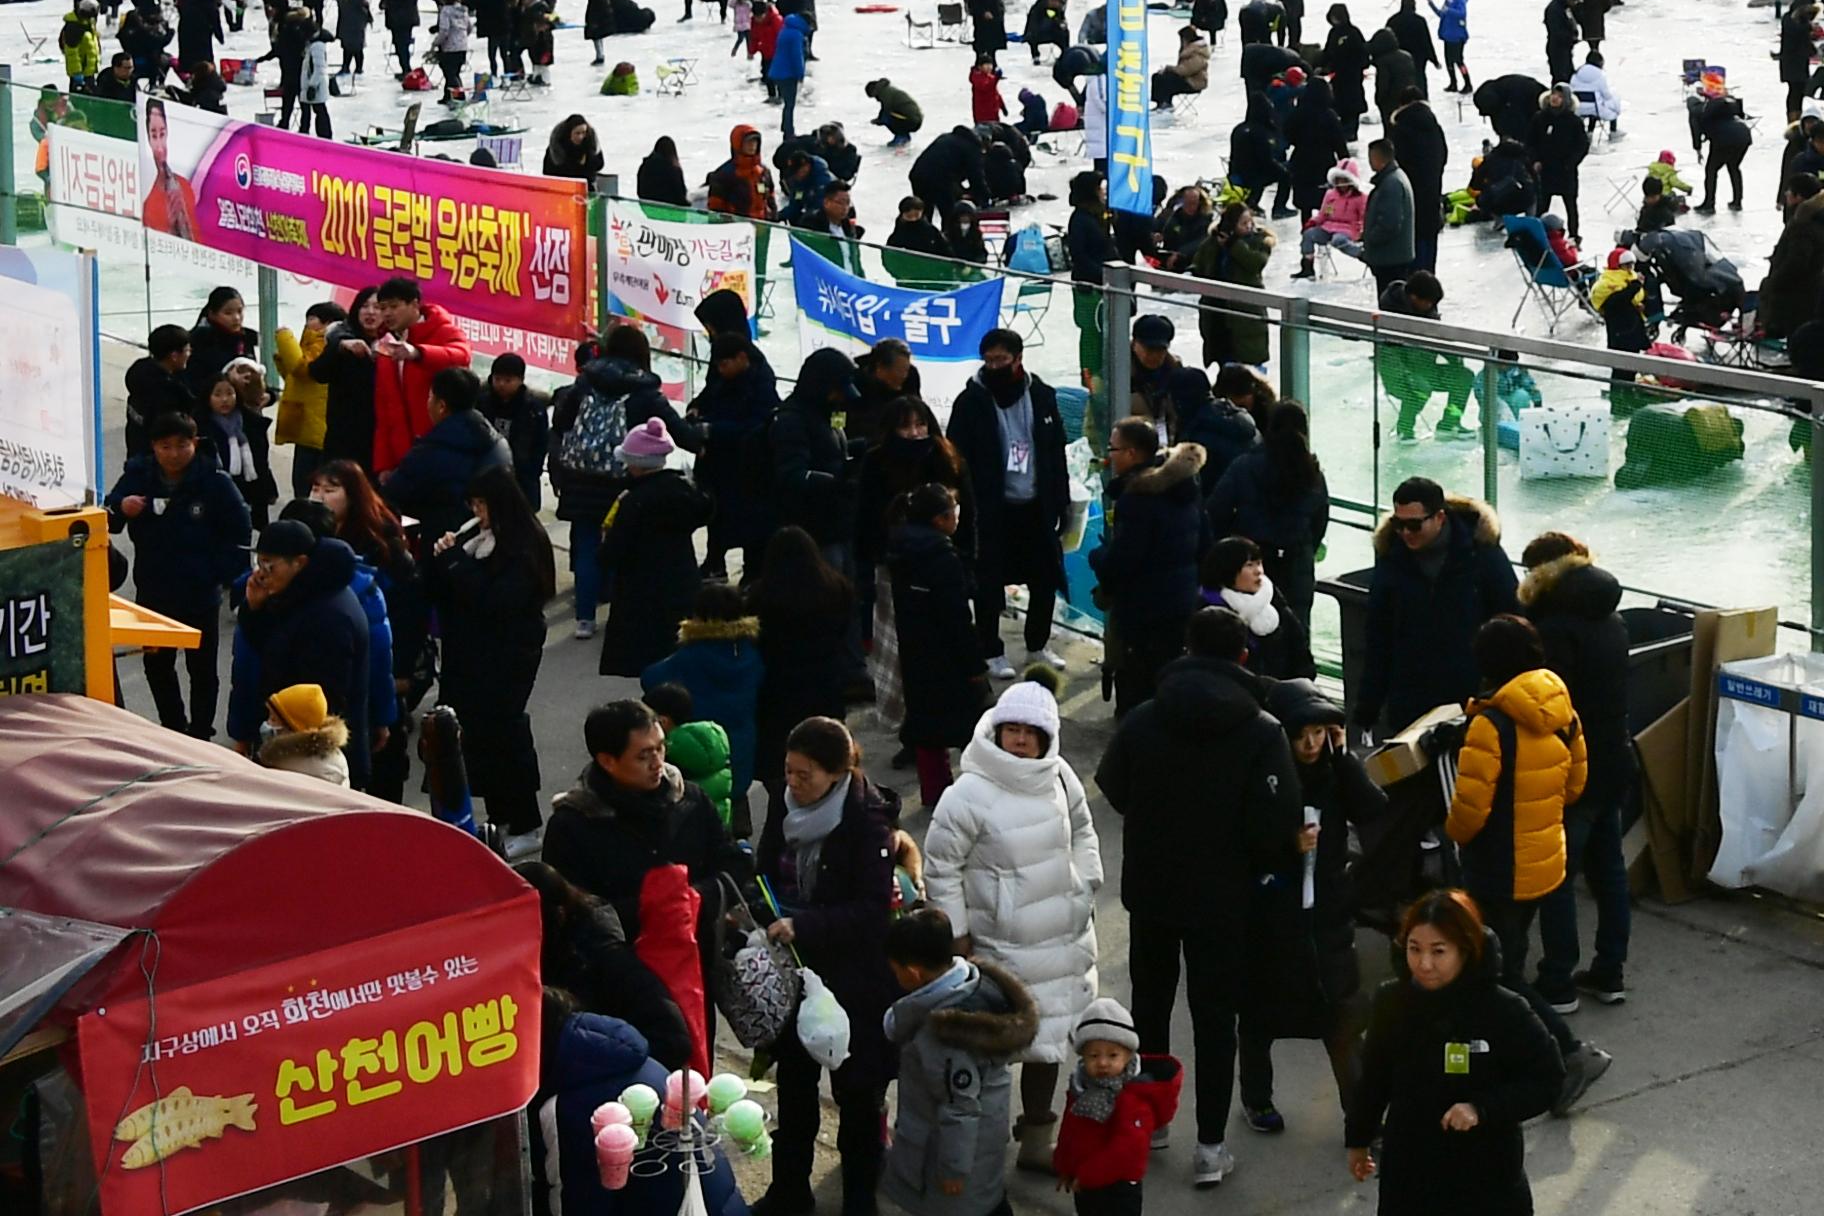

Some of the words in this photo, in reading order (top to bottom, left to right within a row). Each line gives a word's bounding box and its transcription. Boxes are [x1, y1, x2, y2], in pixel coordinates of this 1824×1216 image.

[373, 185, 435, 280] 글로벌
[529, 226, 571, 305] 선정
[141, 1022, 238, 1064] 지구상에서
[242, 1012, 281, 1038] 오직
[281, 983, 383, 1026] 화천에서만
[386, 965, 441, 997] 맛볼수
[443, 954, 480, 981] 있는
[274, 994, 519, 1126] 산천어빵
